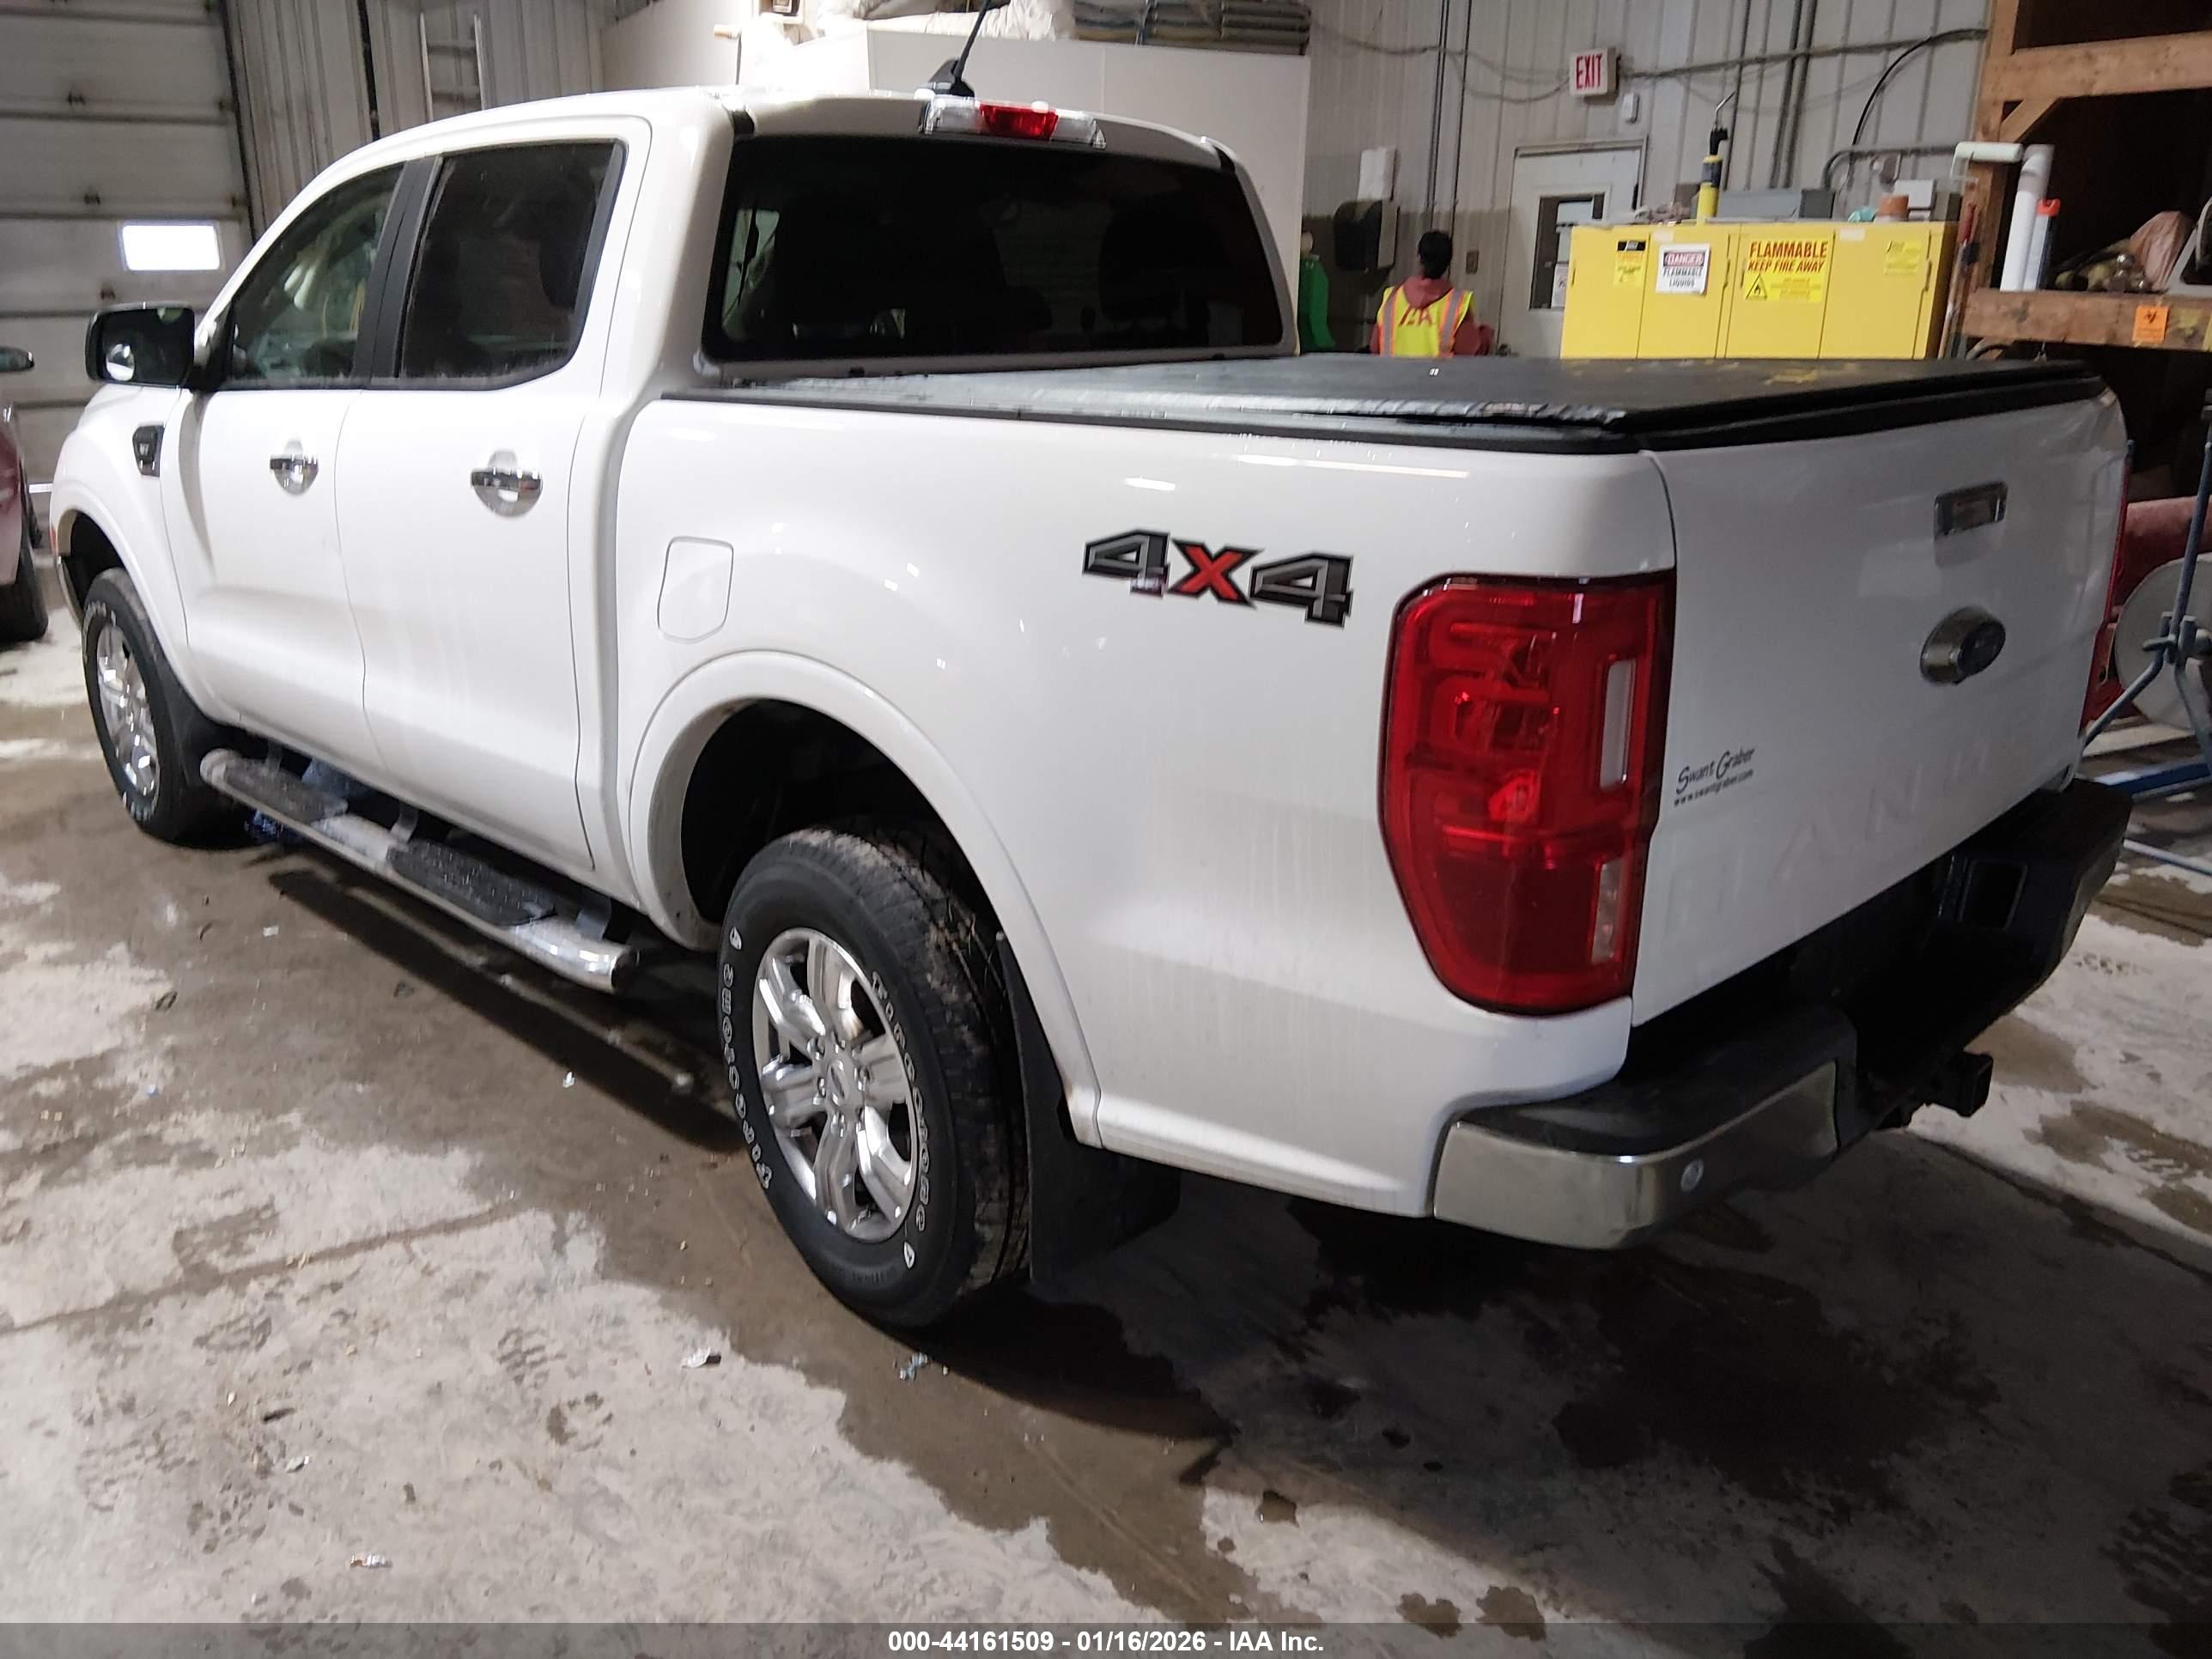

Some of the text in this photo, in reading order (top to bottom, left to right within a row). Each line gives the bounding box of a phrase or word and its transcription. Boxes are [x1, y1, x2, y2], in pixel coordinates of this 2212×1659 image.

[1576, 53, 1602, 90] EXIT
[1749, 240, 1828, 258] FLAMMABLE
[1665, 252, 1703, 265] DANGER
[1662, 265, 1703, 277] FLAMMABLE
[1747, 259, 1825, 274] KEEP FIRE AWAY
